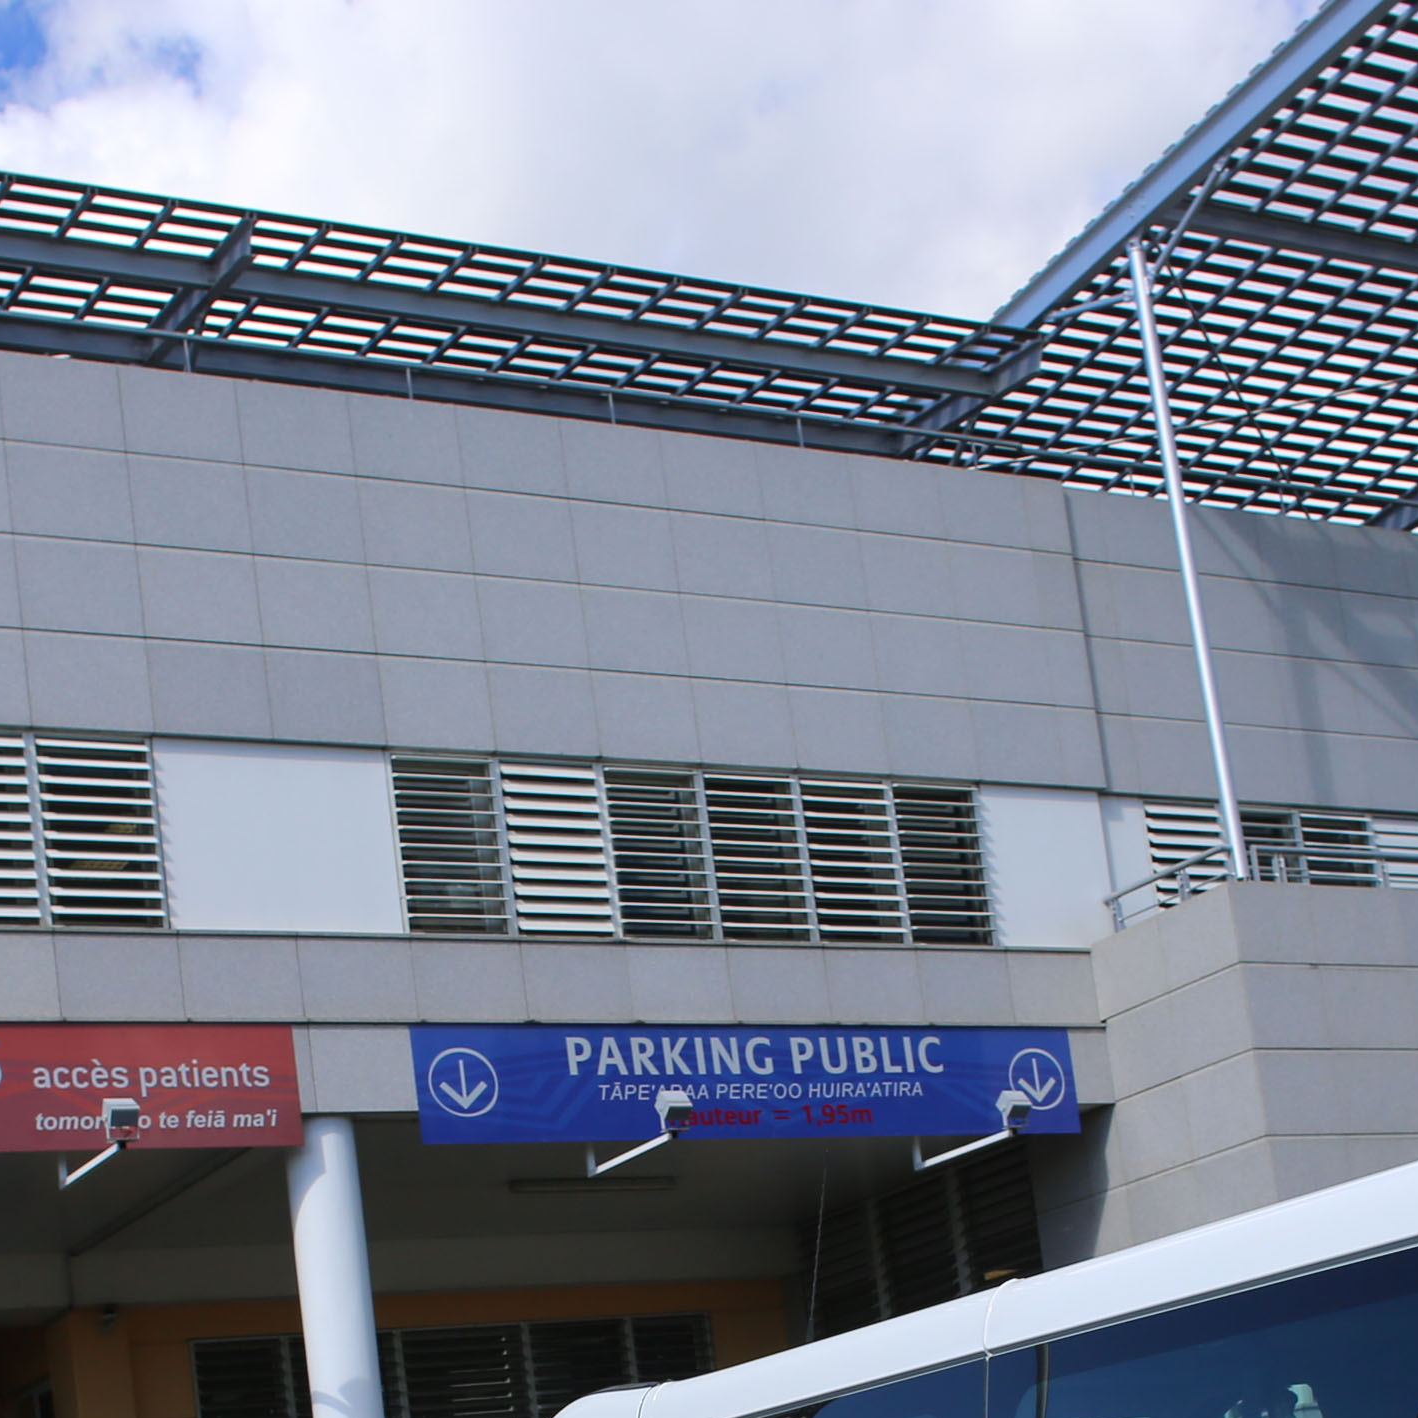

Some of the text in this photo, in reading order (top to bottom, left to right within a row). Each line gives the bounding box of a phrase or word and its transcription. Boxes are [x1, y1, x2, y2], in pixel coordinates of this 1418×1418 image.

[565, 1036, 944, 1075] PARKING PUBLIC
[33, 1059, 271, 1097] accès patients
[716, 1082, 802, 1100] PERE'OO
[809, 1081, 924, 1099] HUIRA'ATIRA
[159, 1111, 180, 1129] te
[804, 1105, 873, 1126] 1,95m
